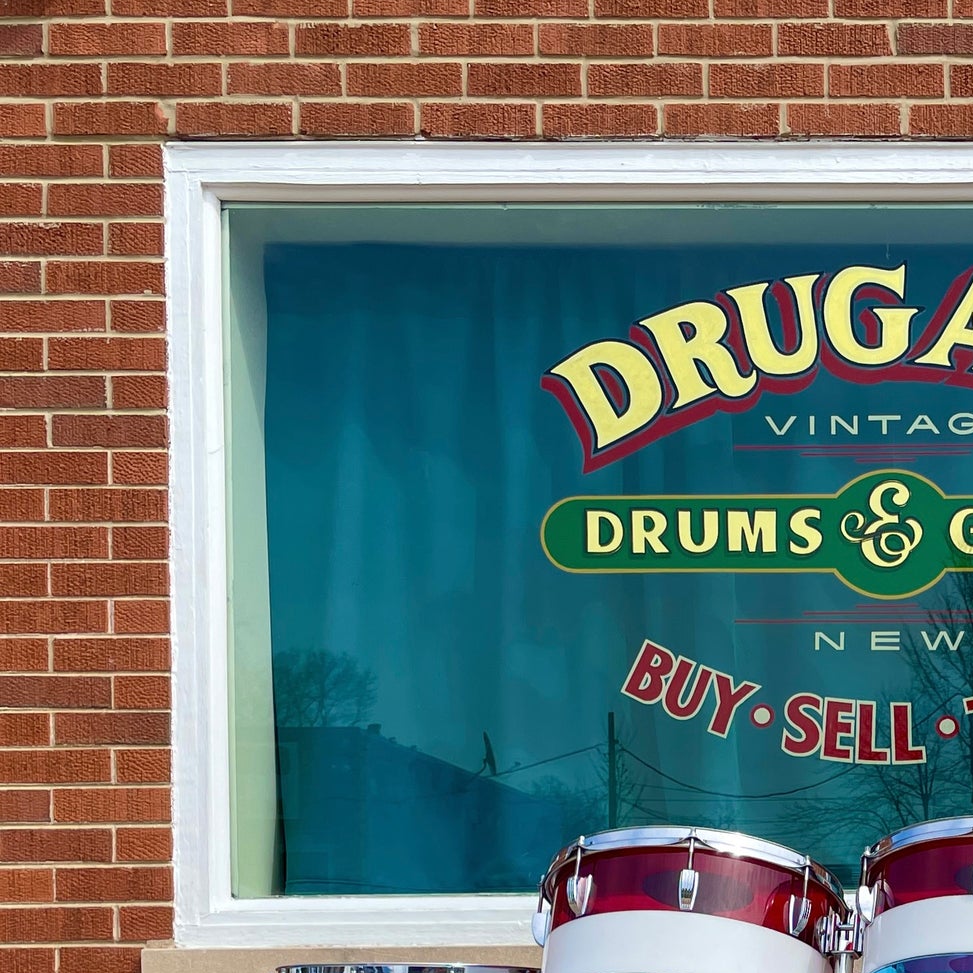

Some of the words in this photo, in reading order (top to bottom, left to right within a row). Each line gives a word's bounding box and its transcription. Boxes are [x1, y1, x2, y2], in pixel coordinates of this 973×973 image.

[584, 508, 824, 555] DRUMS
[840, 480, 922, 568] &
[814, 631, 965, 651] NEW
[620, 639, 761, 739] BUY
[781, 692, 927, 765] SELL
